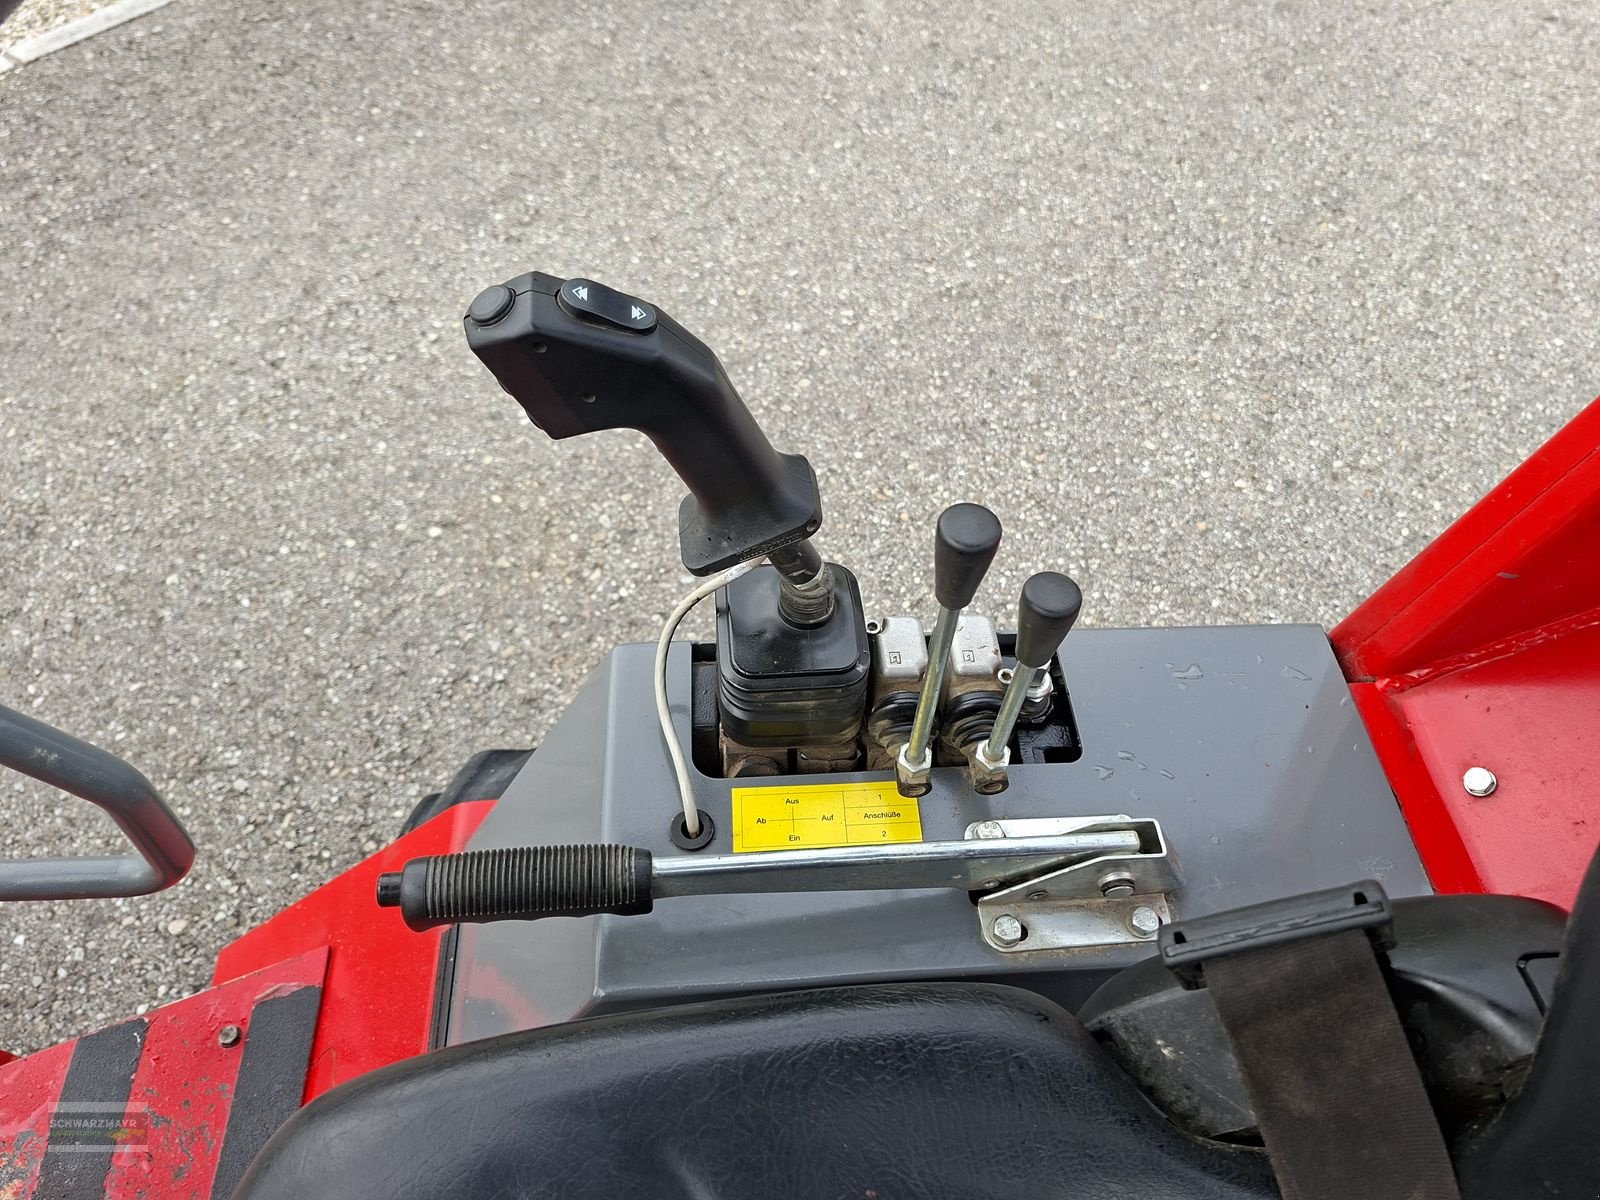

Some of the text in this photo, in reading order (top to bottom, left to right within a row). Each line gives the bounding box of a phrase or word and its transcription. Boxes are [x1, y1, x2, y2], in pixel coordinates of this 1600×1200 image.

[785, 797, 800, 805] Aus
[863, 811, 901, 820] Anschlüße
[756, 817, 767, 825] Ab
[788, 834, 801, 842] Ein
